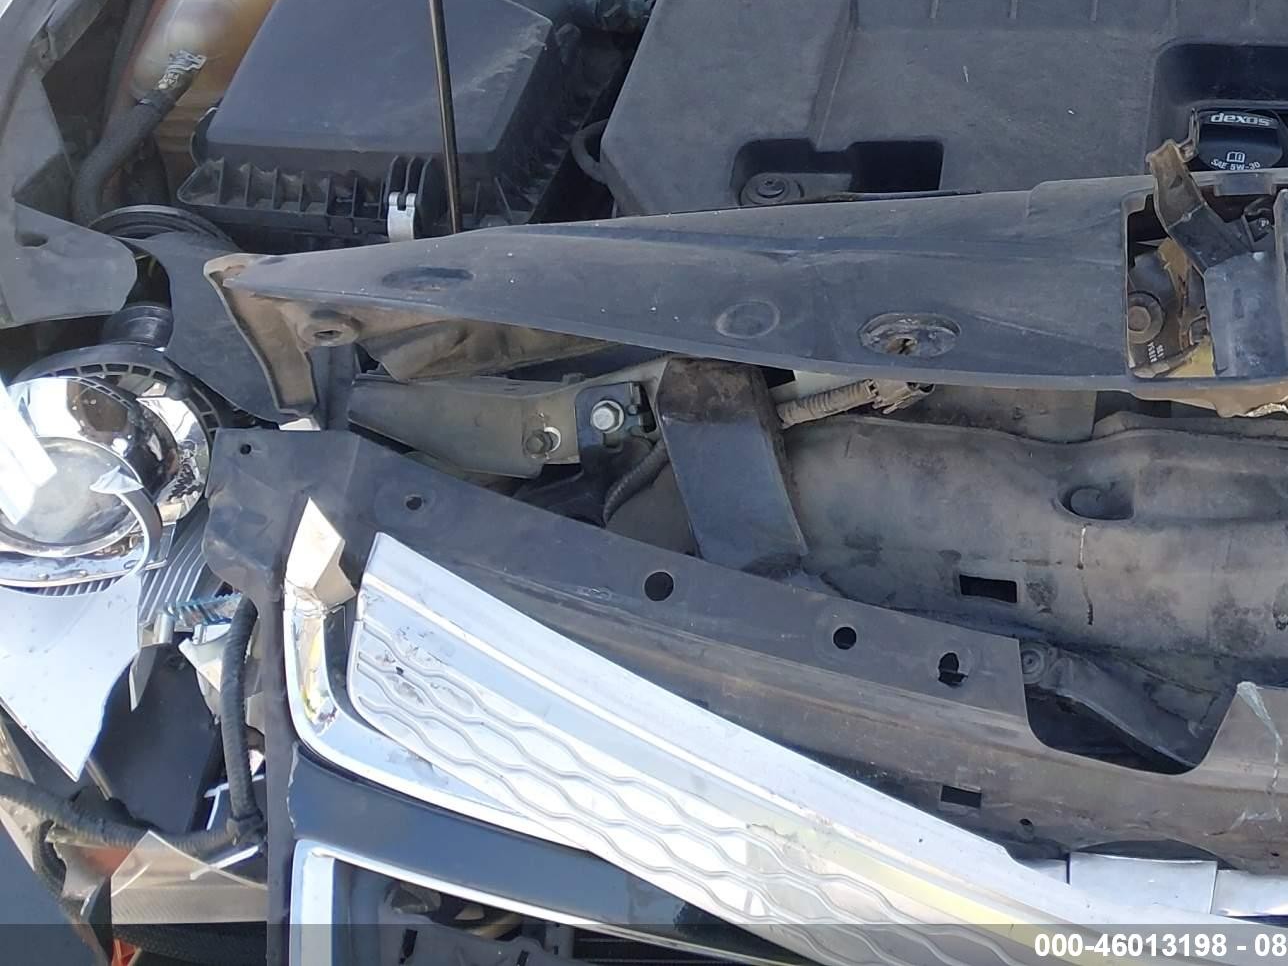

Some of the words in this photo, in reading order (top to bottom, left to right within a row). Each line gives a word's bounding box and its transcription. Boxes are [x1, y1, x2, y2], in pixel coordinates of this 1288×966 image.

[1210, 113, 1271, 127] dexos
[1210, 158, 1229, 170] SAE
[1230, 161, 1261, 171] 5W-30
